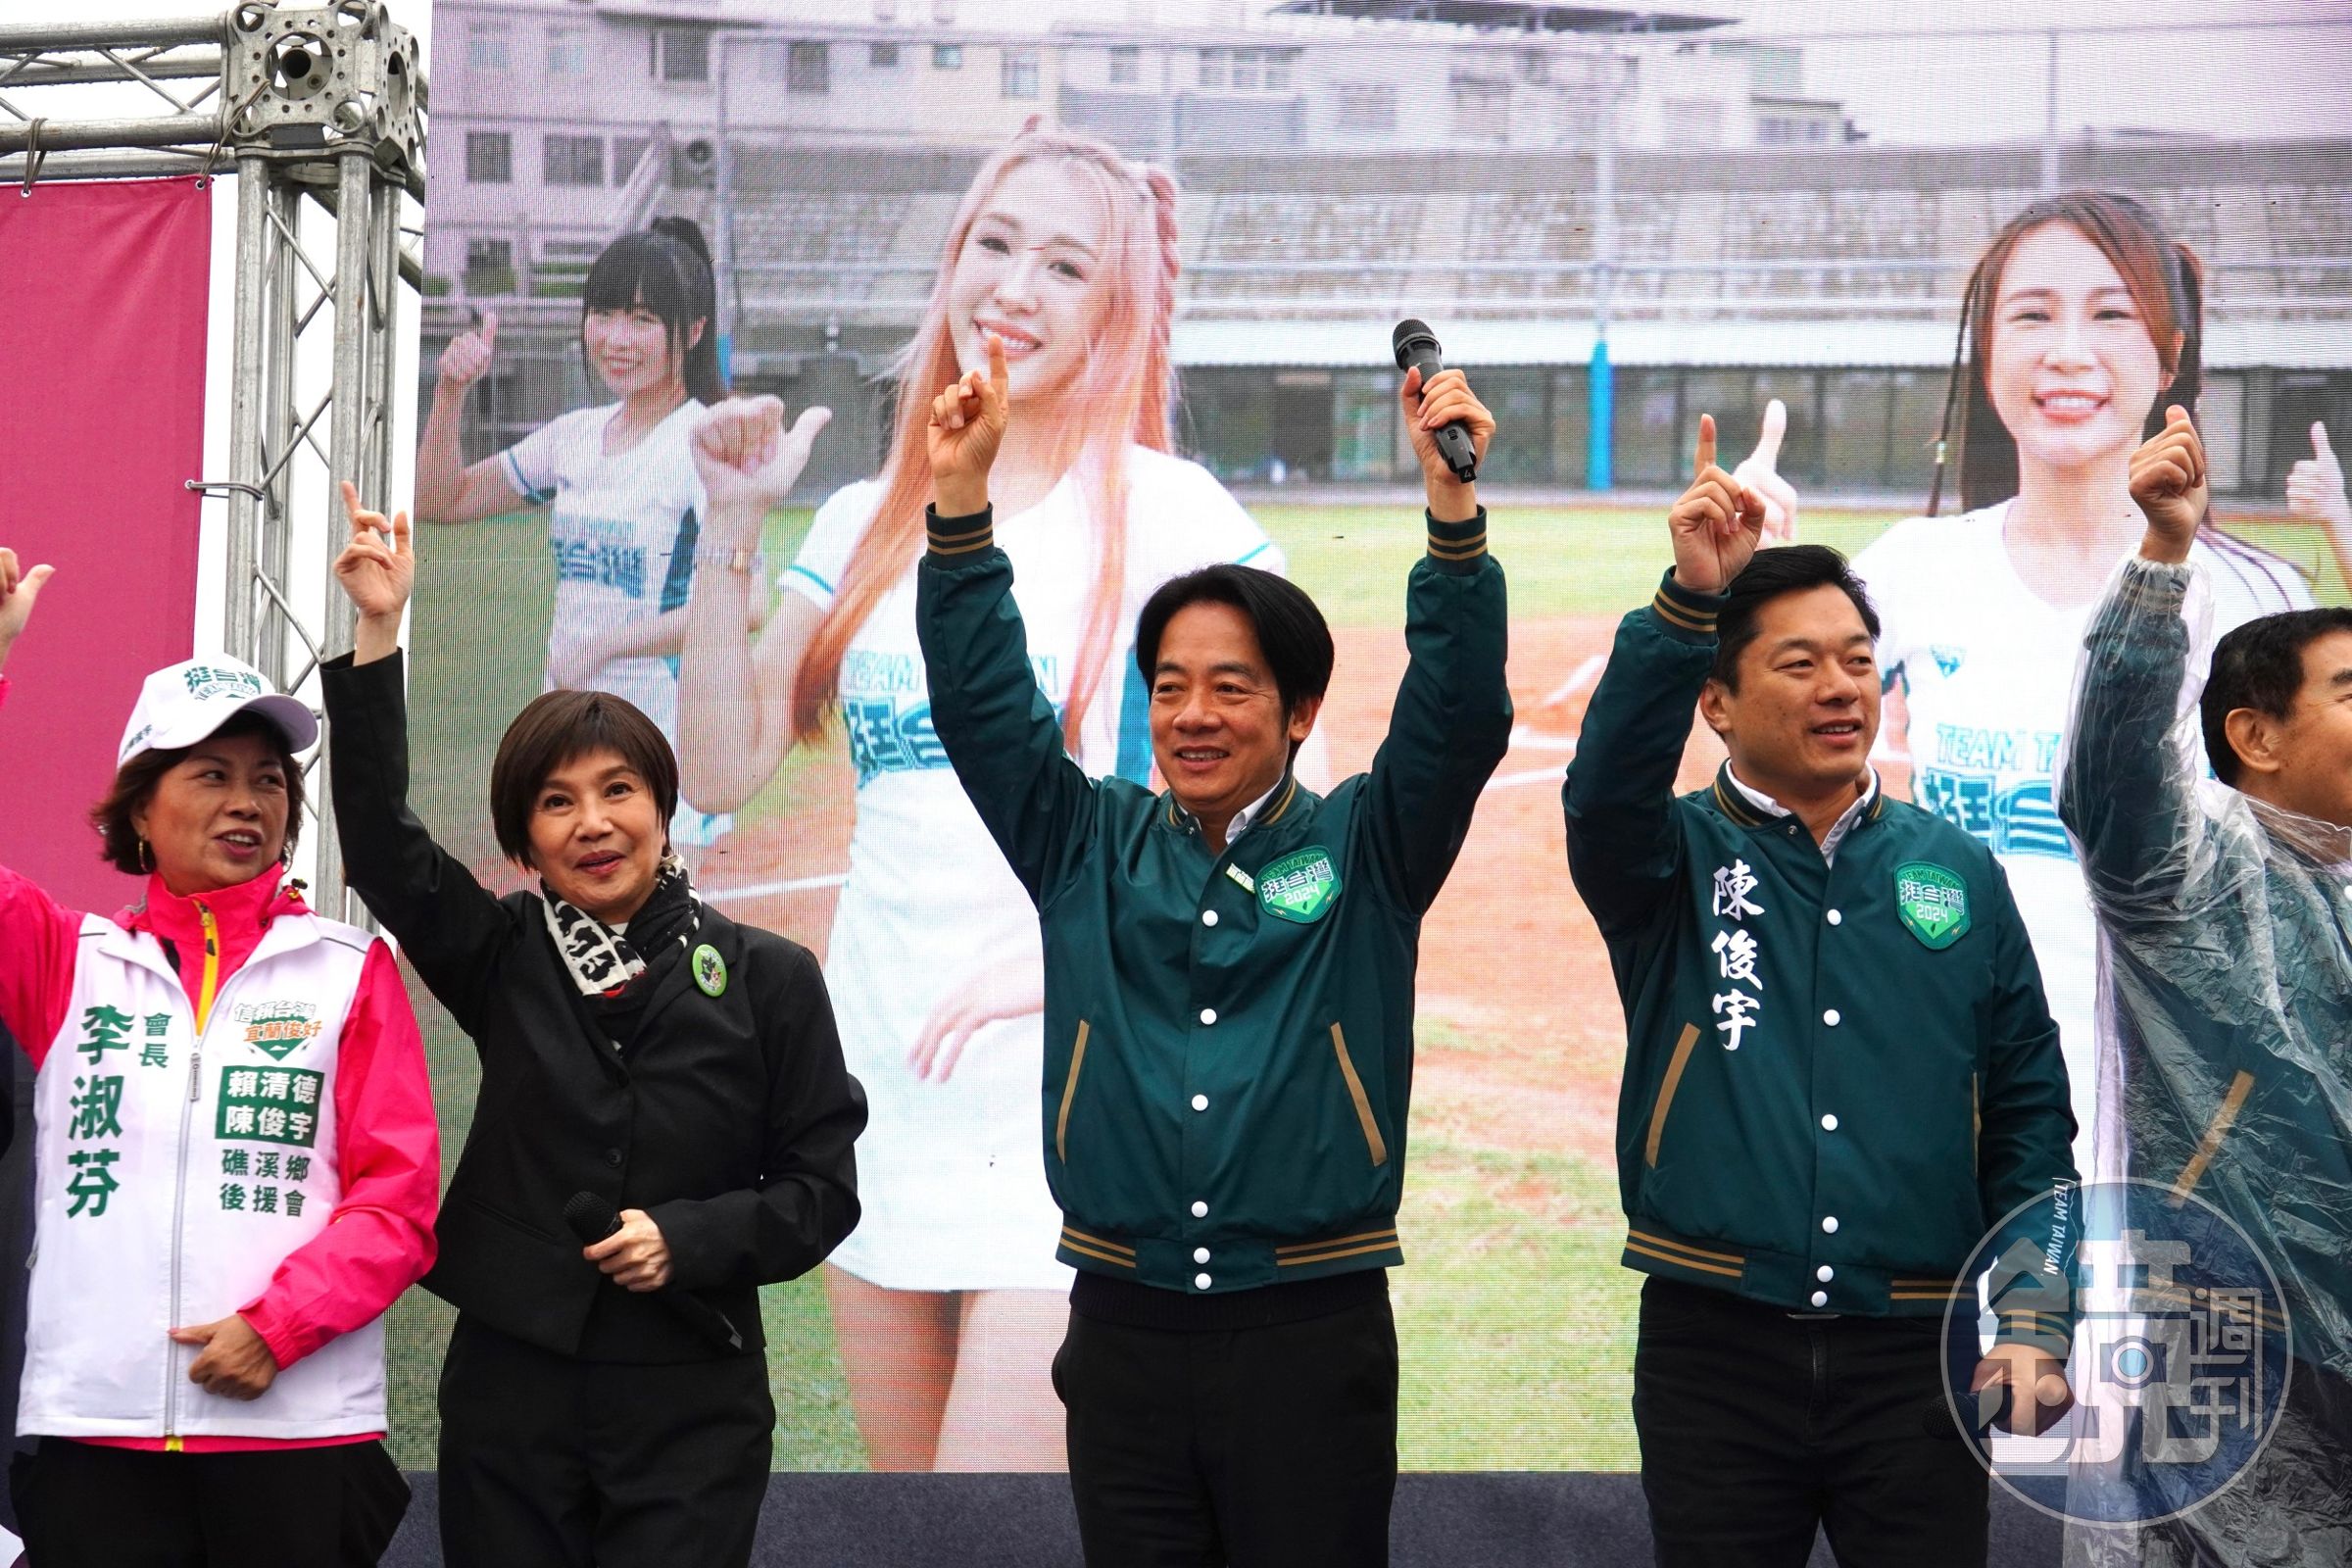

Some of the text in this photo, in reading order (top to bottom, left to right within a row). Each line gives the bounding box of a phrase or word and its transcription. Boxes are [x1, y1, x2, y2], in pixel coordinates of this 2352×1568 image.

[552, 539, 645, 599] 台灣
[1936, 723, 2031, 771] TEAM
[1261, 858, 1334, 904] 挺台灣
[1284, 884, 1321, 906] 2024
[1899, 878, 1965, 916] 挺台灣
[1916, 903, 1949, 923] 2024
[1711, 858, 1765, 1052] 陳俊宇
[138, 1012, 172, 1069] 會長
[243, 1020, 323, 1043] 宜蘭俊好
[226, 1071, 318, 1104] 賴清德
[66, 1004, 135, 1219] 李淑芬
[224, 1104, 314, 1141] 陳俊宇
[221, 1149, 311, 1184] 礁溪鄉
[220, 1183, 307, 1217] 後援會
[2042, 1183, 2069, 1276] TEAM TAIWAN
